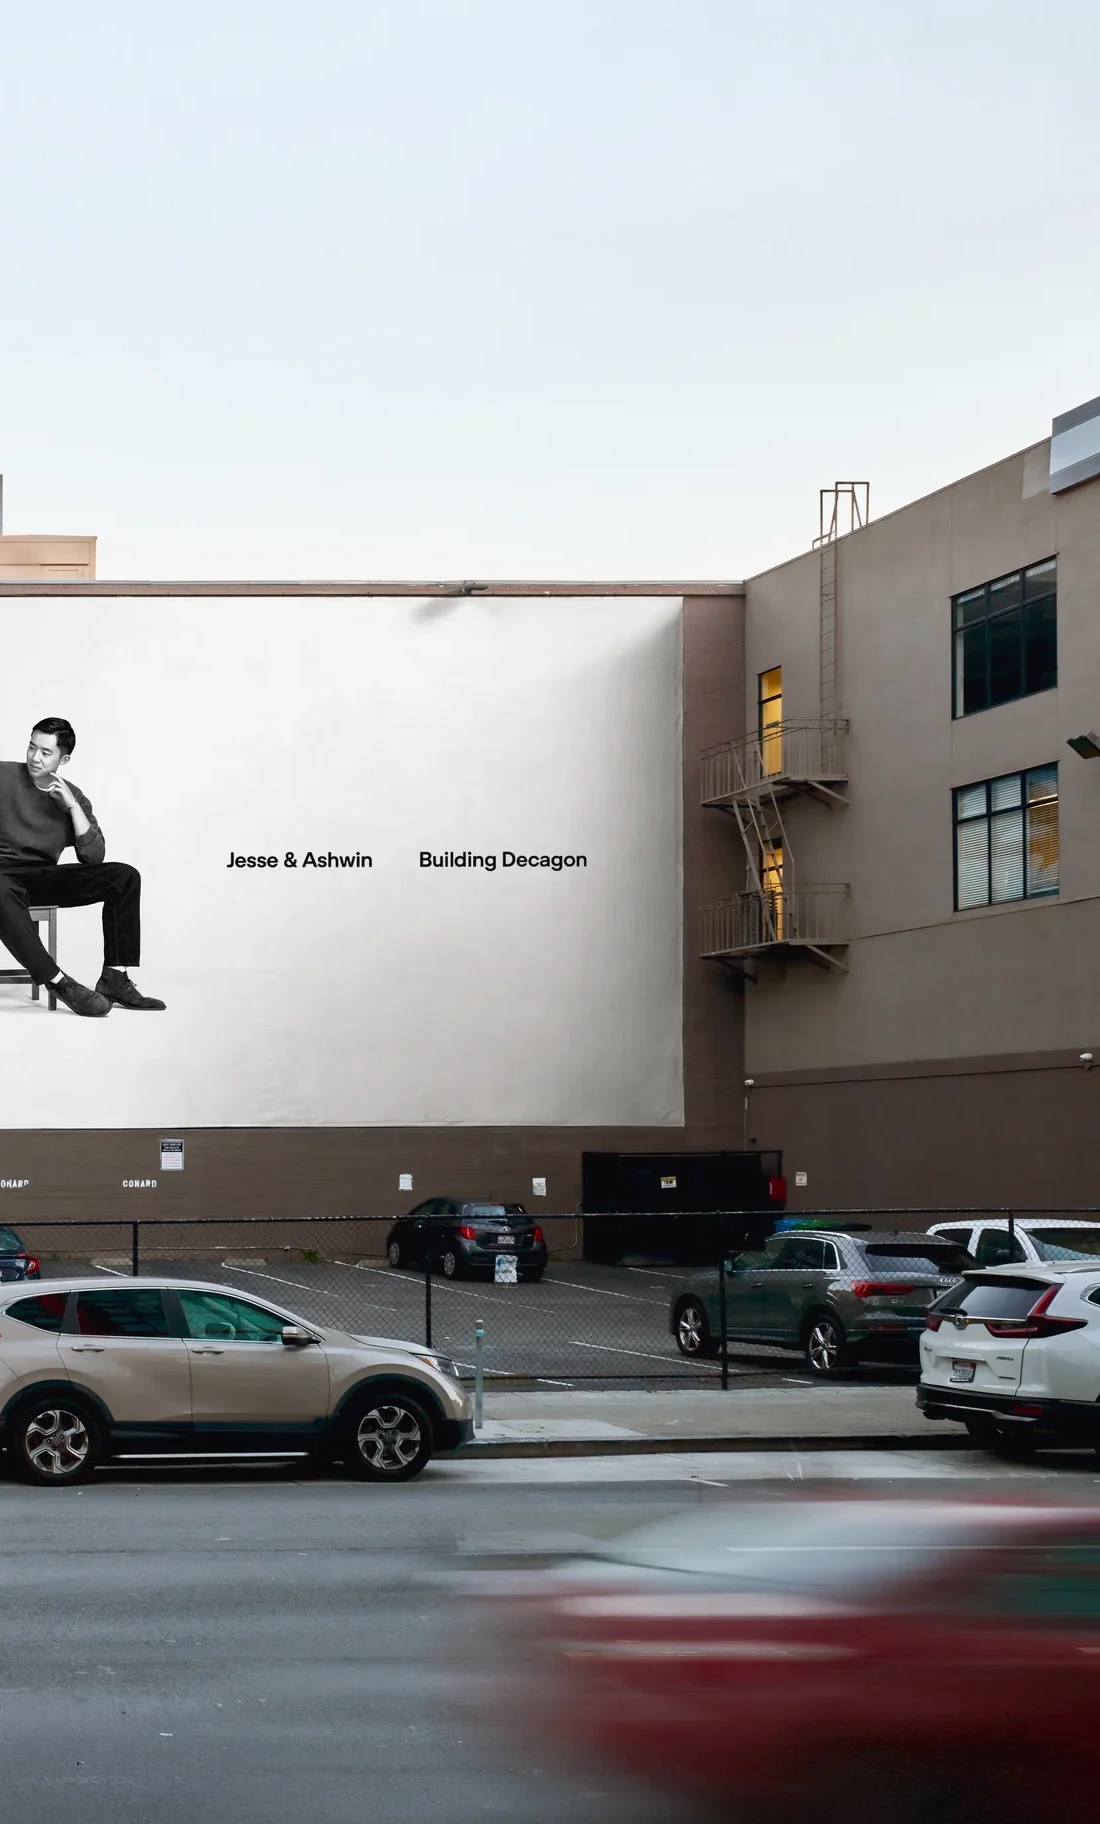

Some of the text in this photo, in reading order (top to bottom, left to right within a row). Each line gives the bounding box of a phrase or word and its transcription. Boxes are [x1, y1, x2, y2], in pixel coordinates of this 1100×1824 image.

[226, 851, 373, 868] Jesse & Ashwin
[419, 851, 588, 872] Building Decagon
[122, 1179, 157, 1188] CONARD
